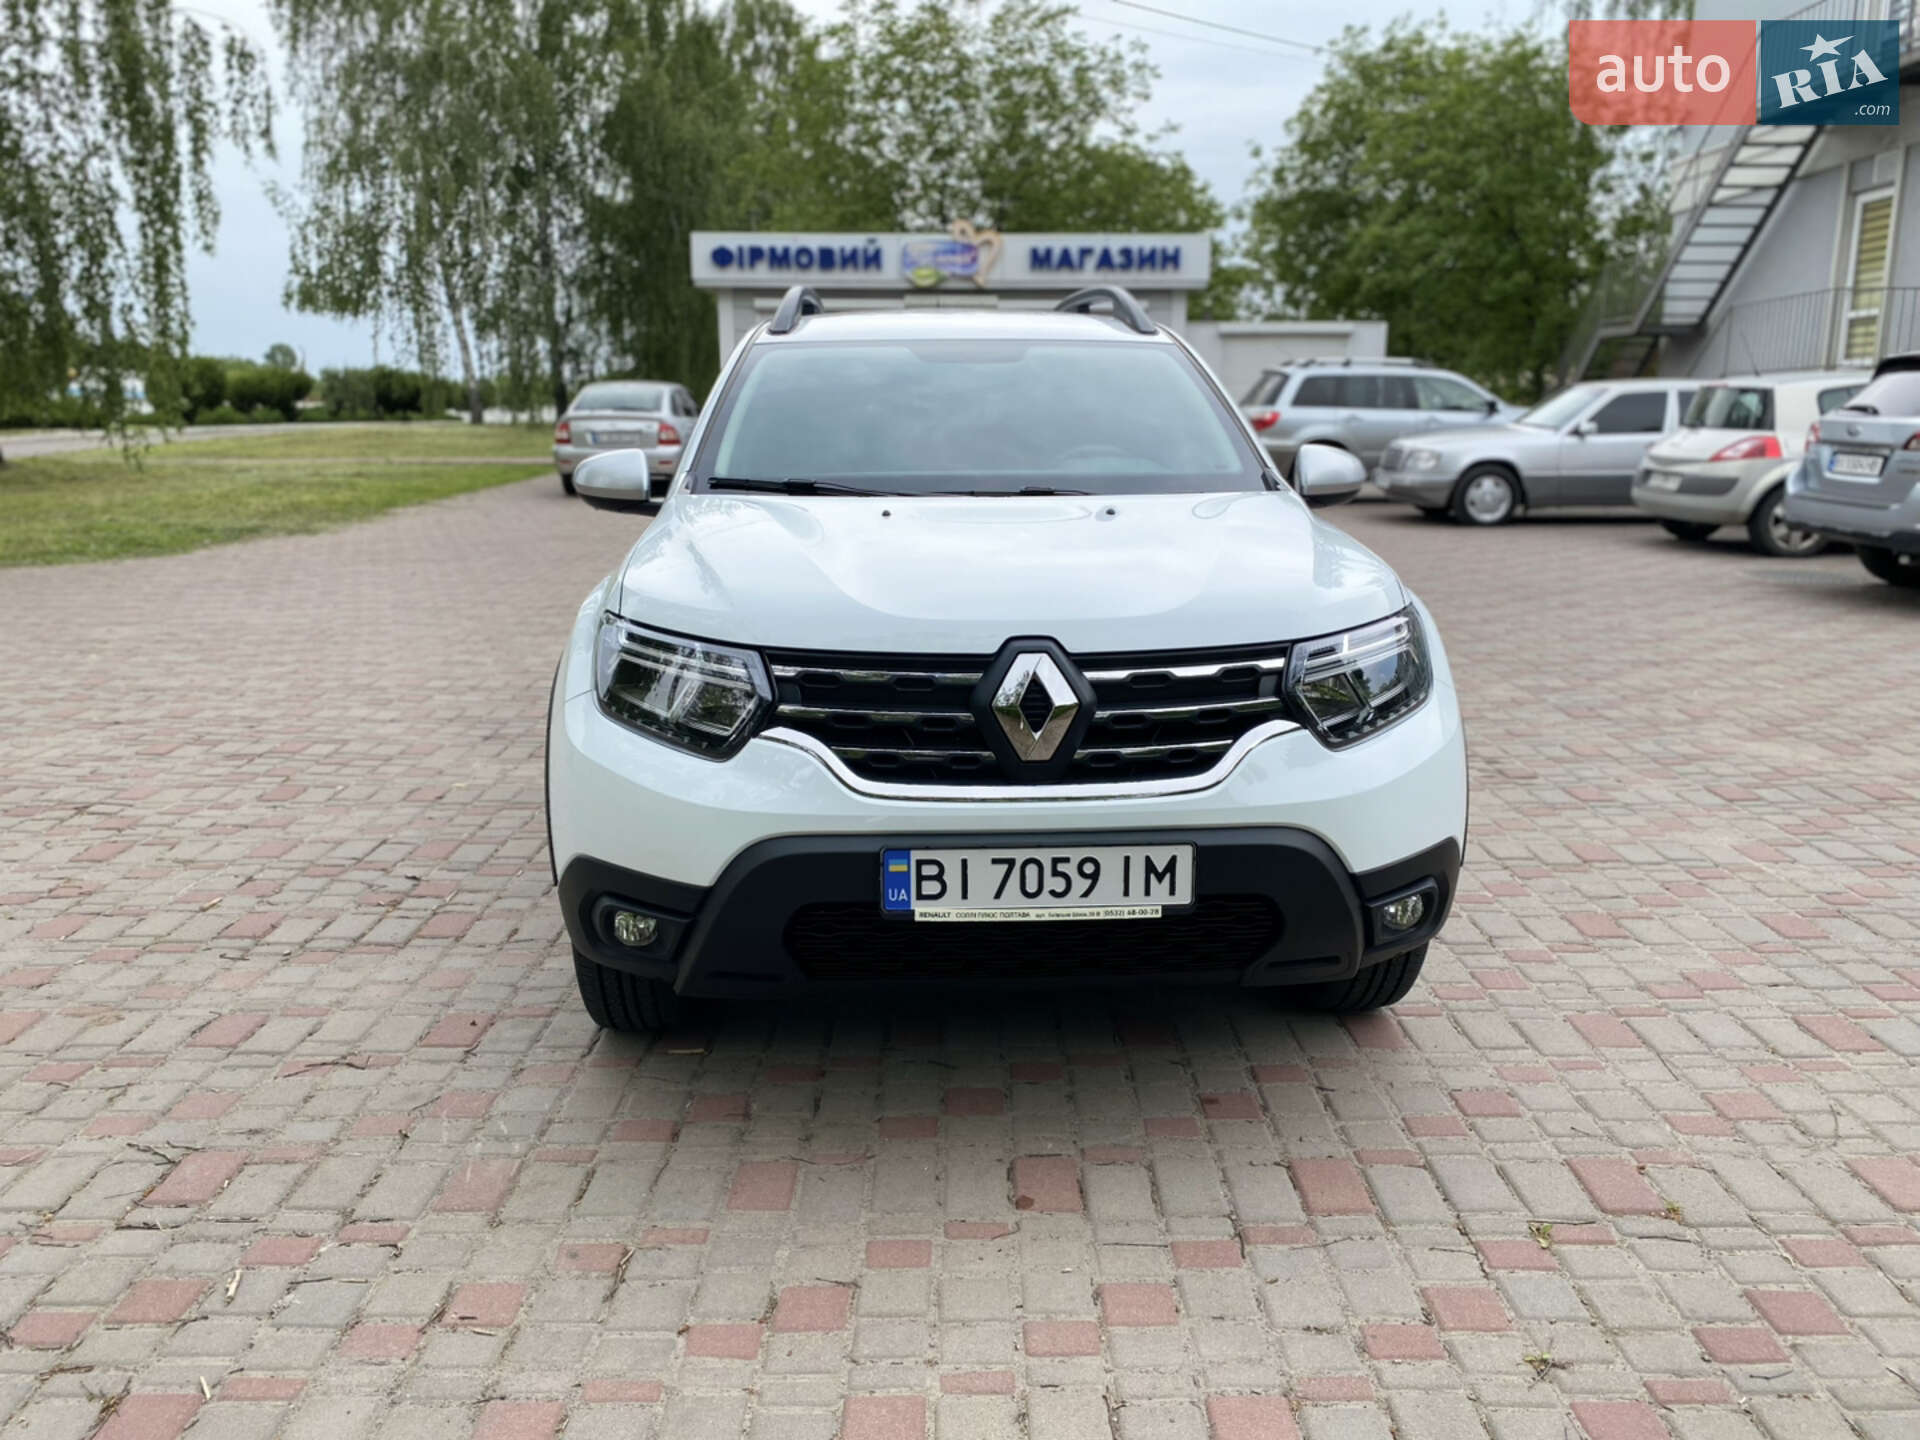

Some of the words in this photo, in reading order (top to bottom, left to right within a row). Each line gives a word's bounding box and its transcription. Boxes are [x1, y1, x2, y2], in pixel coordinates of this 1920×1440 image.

[711, 238, 882, 272] ФІРМОВИЙ
[1029, 246, 1182, 272] МАГАЗИН
[915, 857, 968, 901] BI
[991, 856, 1101, 900] 7059
[1122, 854, 1178, 898] IM
[888, 888, 908, 902] UA
[919, 911, 951, 919] RENAULT
